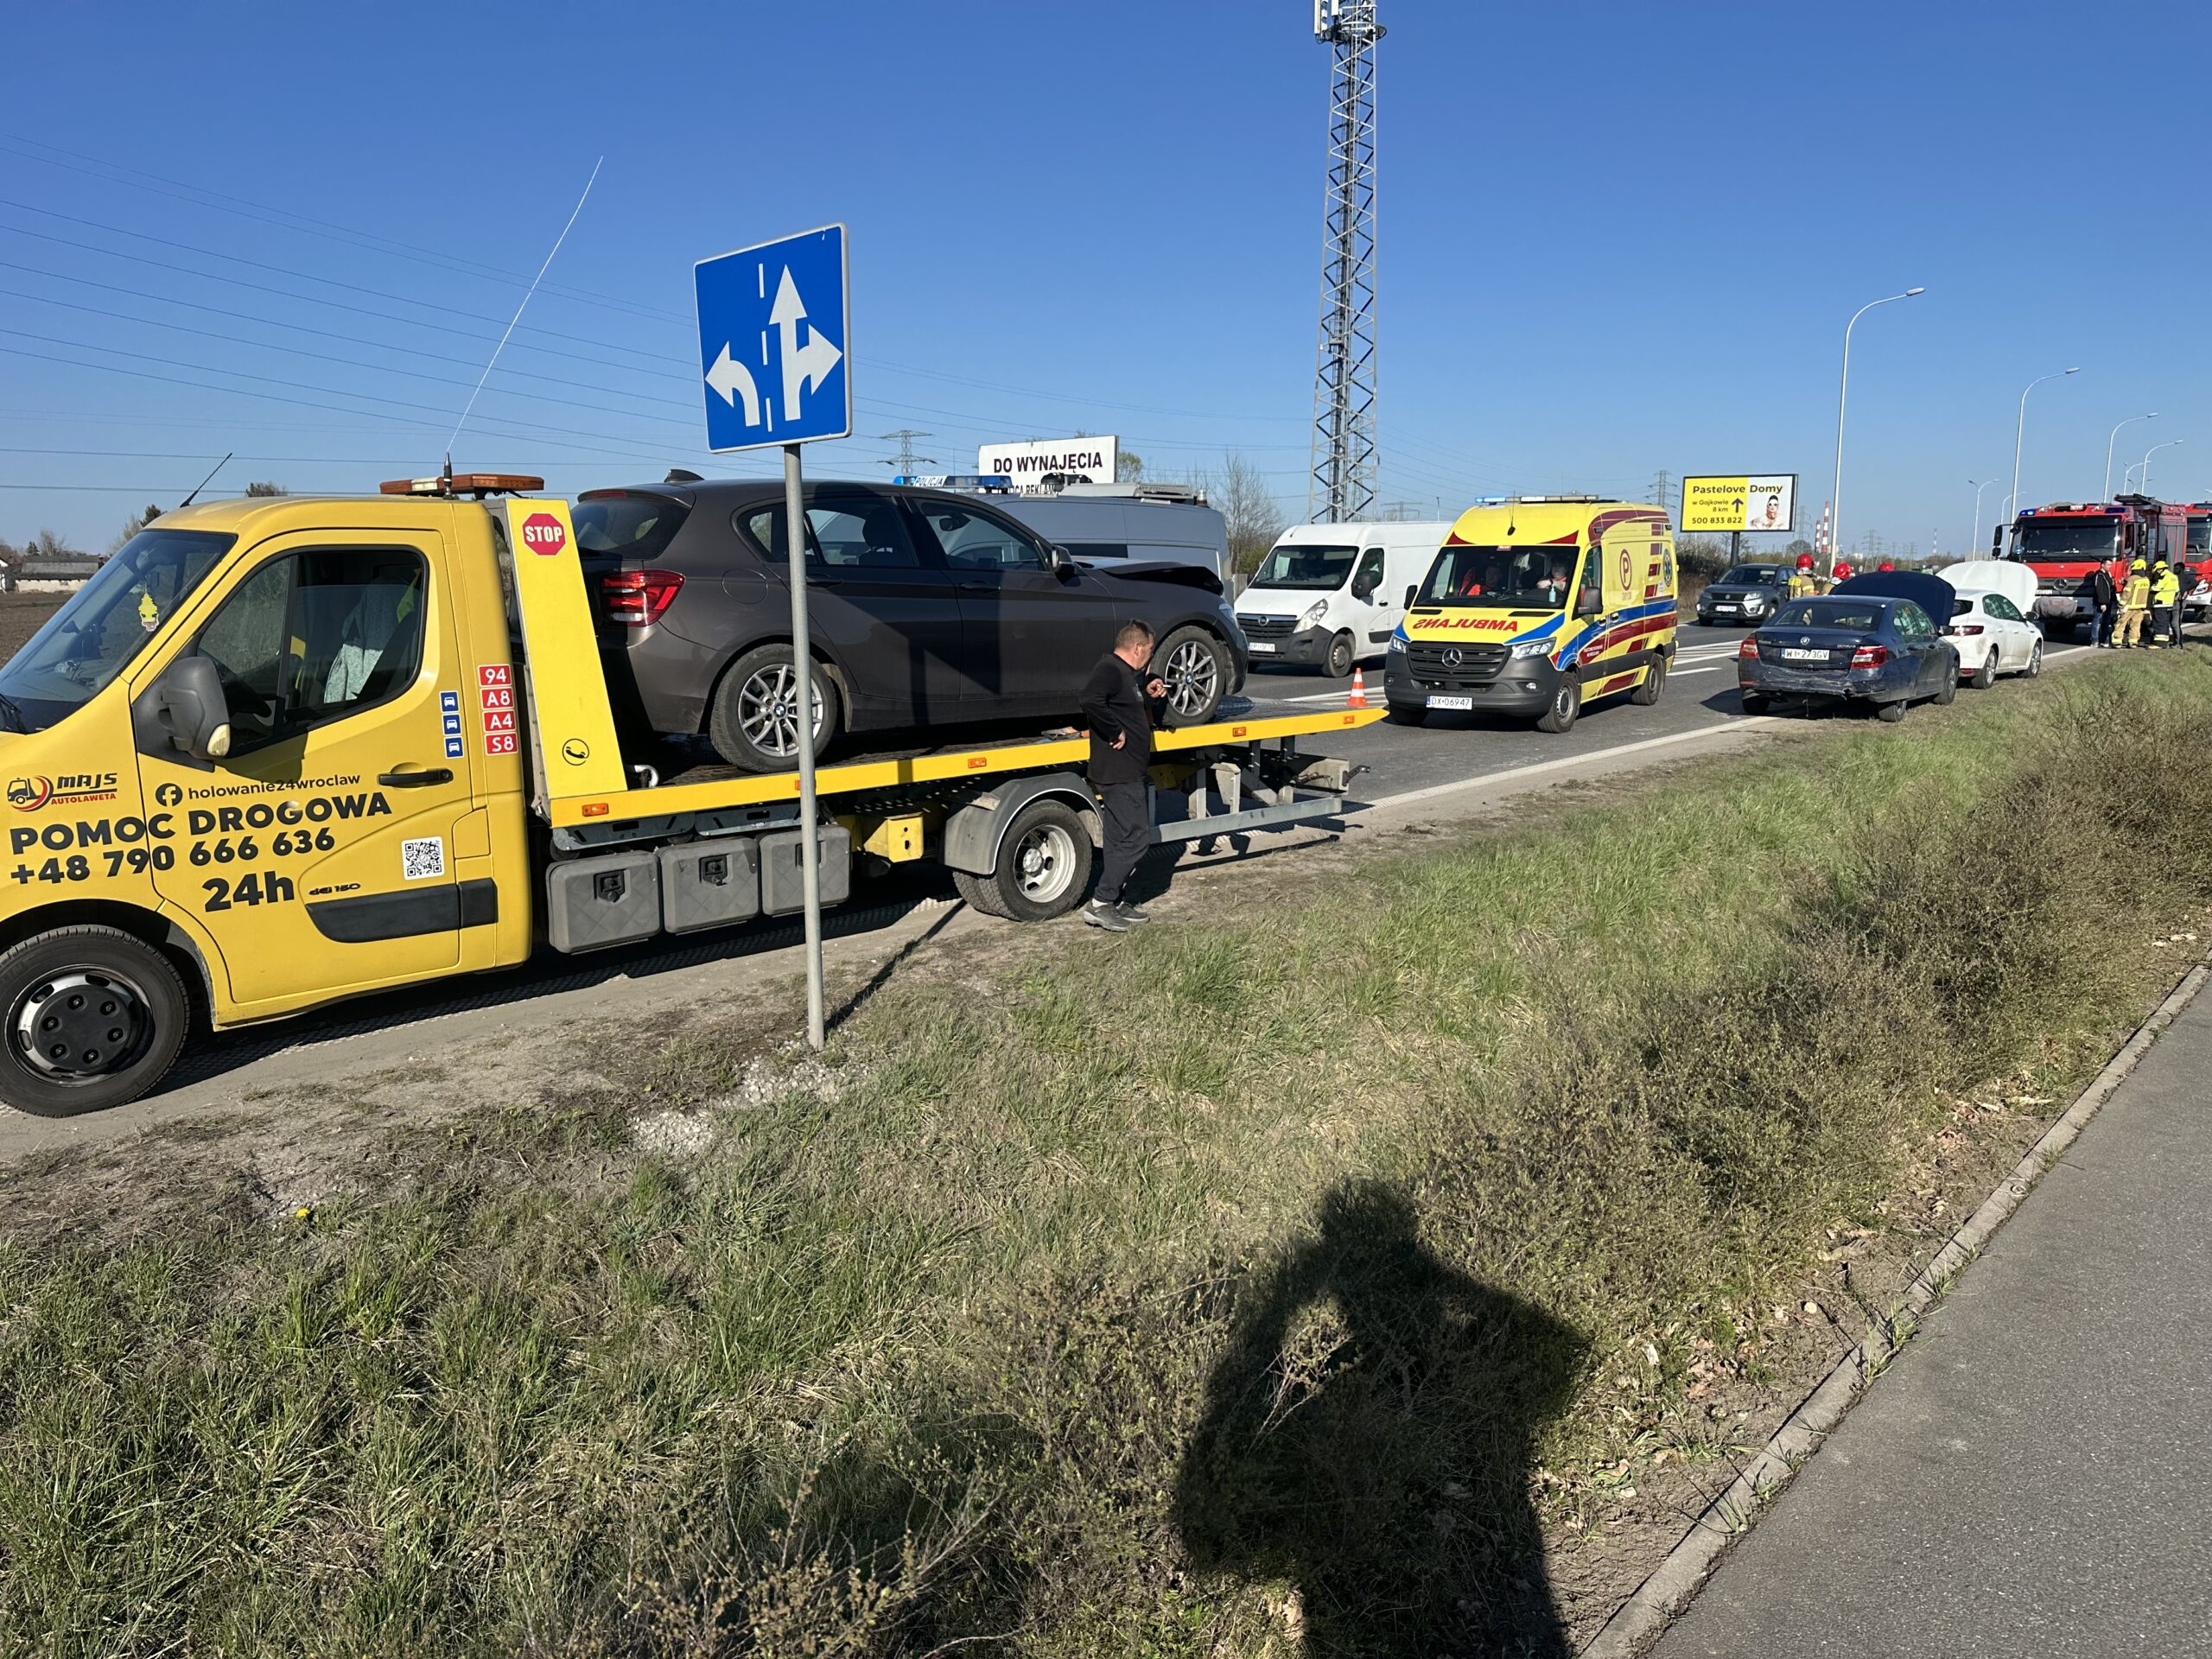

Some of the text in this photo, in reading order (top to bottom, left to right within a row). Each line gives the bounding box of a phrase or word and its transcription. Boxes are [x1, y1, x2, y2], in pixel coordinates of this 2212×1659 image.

[994, 452, 1103, 474] DO WYNAJĘCIA
[916, 476, 944, 486] POLICJA
[1693, 485, 1783, 494] Pastelove Domy
[524, 525, 563, 543] STOP
[485, 668, 507, 683] 94
[486, 690, 511, 706] A8
[1431, 696, 1471, 707] DX 06947
[490, 714, 512, 728] A4
[492, 737, 515, 752] S8
[188, 775, 360, 799] holowanie24wroclaw
[51, 793, 117, 805] AUTOLAWETA
[10, 791, 392, 855] POMOC DROGOWA
[10, 827, 335, 885] +48 790 666 636
[201, 871, 295, 912] 24h
